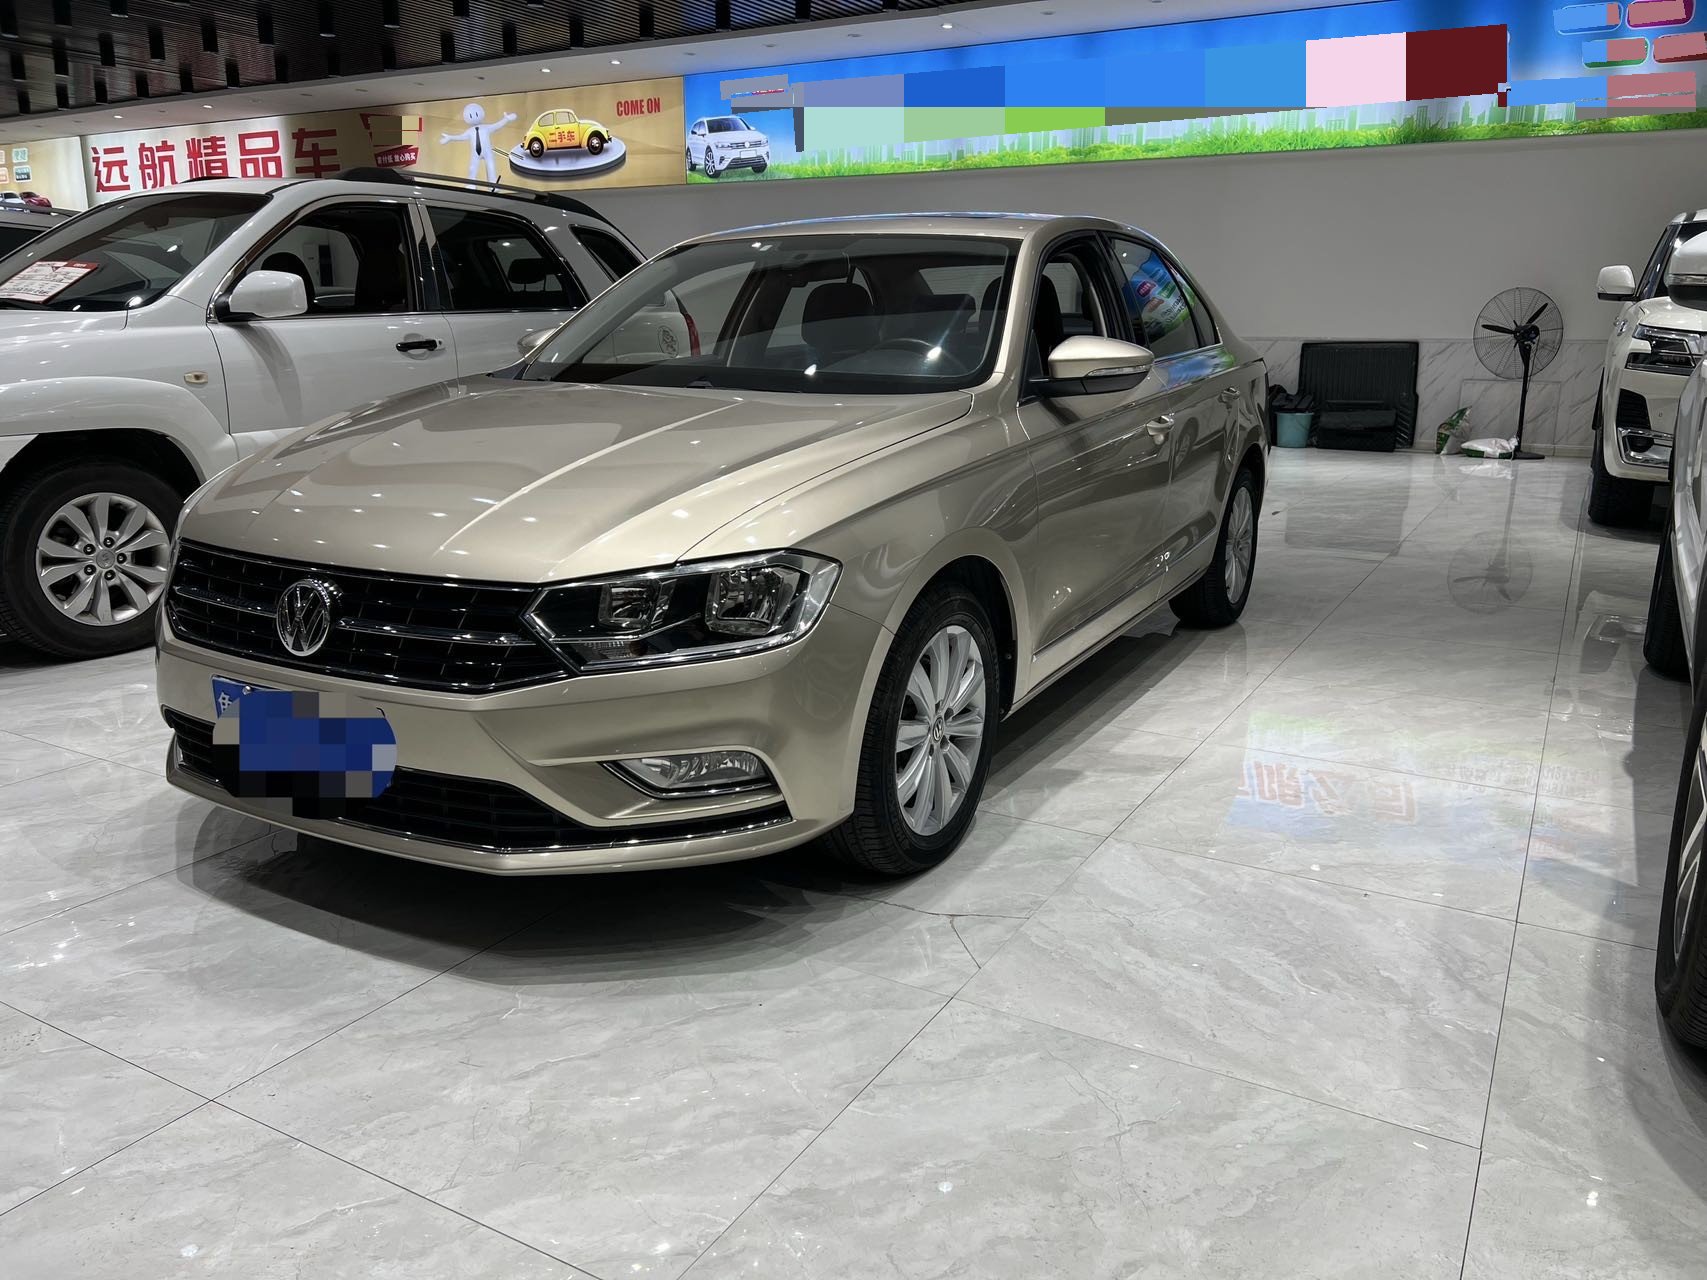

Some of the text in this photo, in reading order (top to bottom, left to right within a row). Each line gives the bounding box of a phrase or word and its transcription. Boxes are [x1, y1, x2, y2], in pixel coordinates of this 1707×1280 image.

[616, 97, 661, 117] COME ON
[91, 128, 341, 193] 远航精品车
